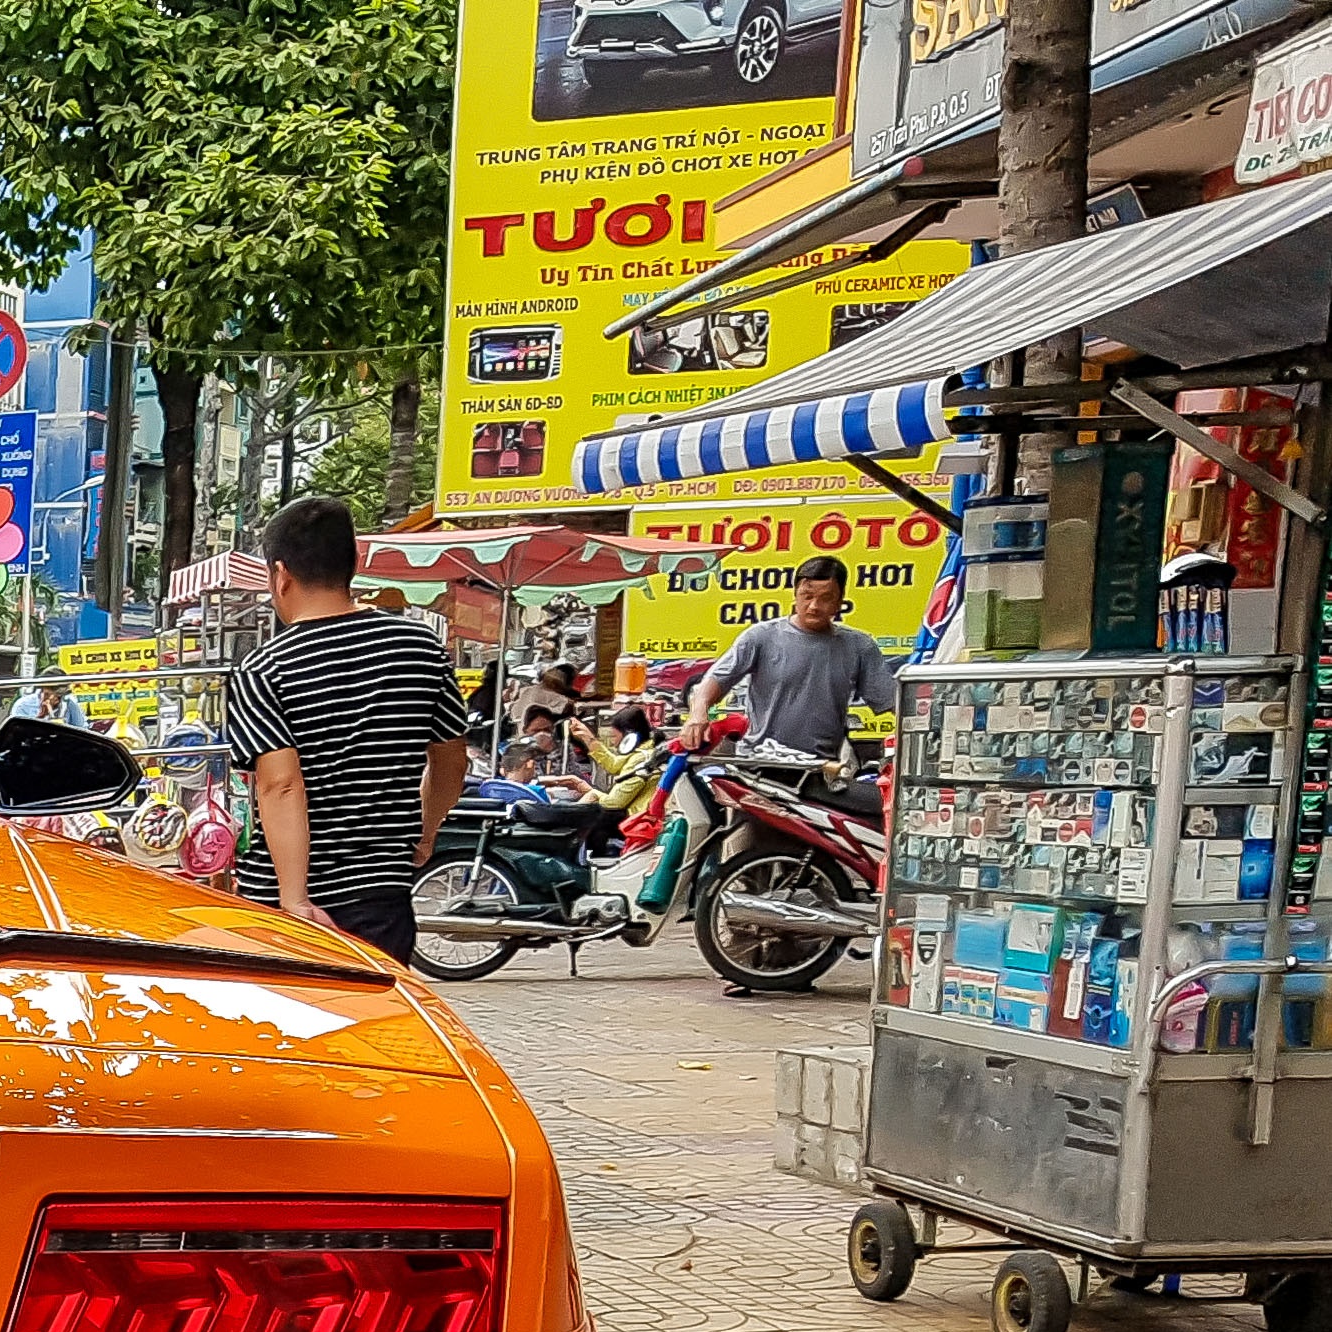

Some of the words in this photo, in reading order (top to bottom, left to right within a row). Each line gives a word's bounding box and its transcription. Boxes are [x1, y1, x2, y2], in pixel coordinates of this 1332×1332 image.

[476, 148, 541, 167] TRUNG
[546, 141, 586, 160] TÂM
[591, 136, 657, 156] TRANG
[662, 129, 697, 151] TRÍ
[702, 129, 741, 147] NỘI
[760, 122, 826, 143] NGOẠI
[540, 166, 578, 185] PHỤ
[585, 162, 631, 182] KIỆN
[637, 157, 666, 176] ĐỒ
[671, 153, 723, 173] CHƠI
[727, 153, 753, 169] XE
[464, 194, 707, 258] TƯƠI
[540, 265, 569, 287] Uy
[621, 255, 675, 280] Chất
[845, 276, 906, 292] CERAMIC
[908, 275, 925, 289] XE
[520, 297, 579, 314] ANDROID
[526, 396, 563, 410] 6D-8D
[592, 393, 626, 406] PHIM
[628, 387, 661, 405] CÁCH
[664, 385, 704, 404] NHIỆT
[445, 492, 468, 506] 553
[473, 493, 491, 505] AN
[494, 489, 541, 504] DƯƠNG
[634, 484, 656, 499] Q.5
[667, 481, 716, 496] TP.HCM
[810, 508, 942, 551] ÔTÔ
[856, 562, 914, 588] HƠI
